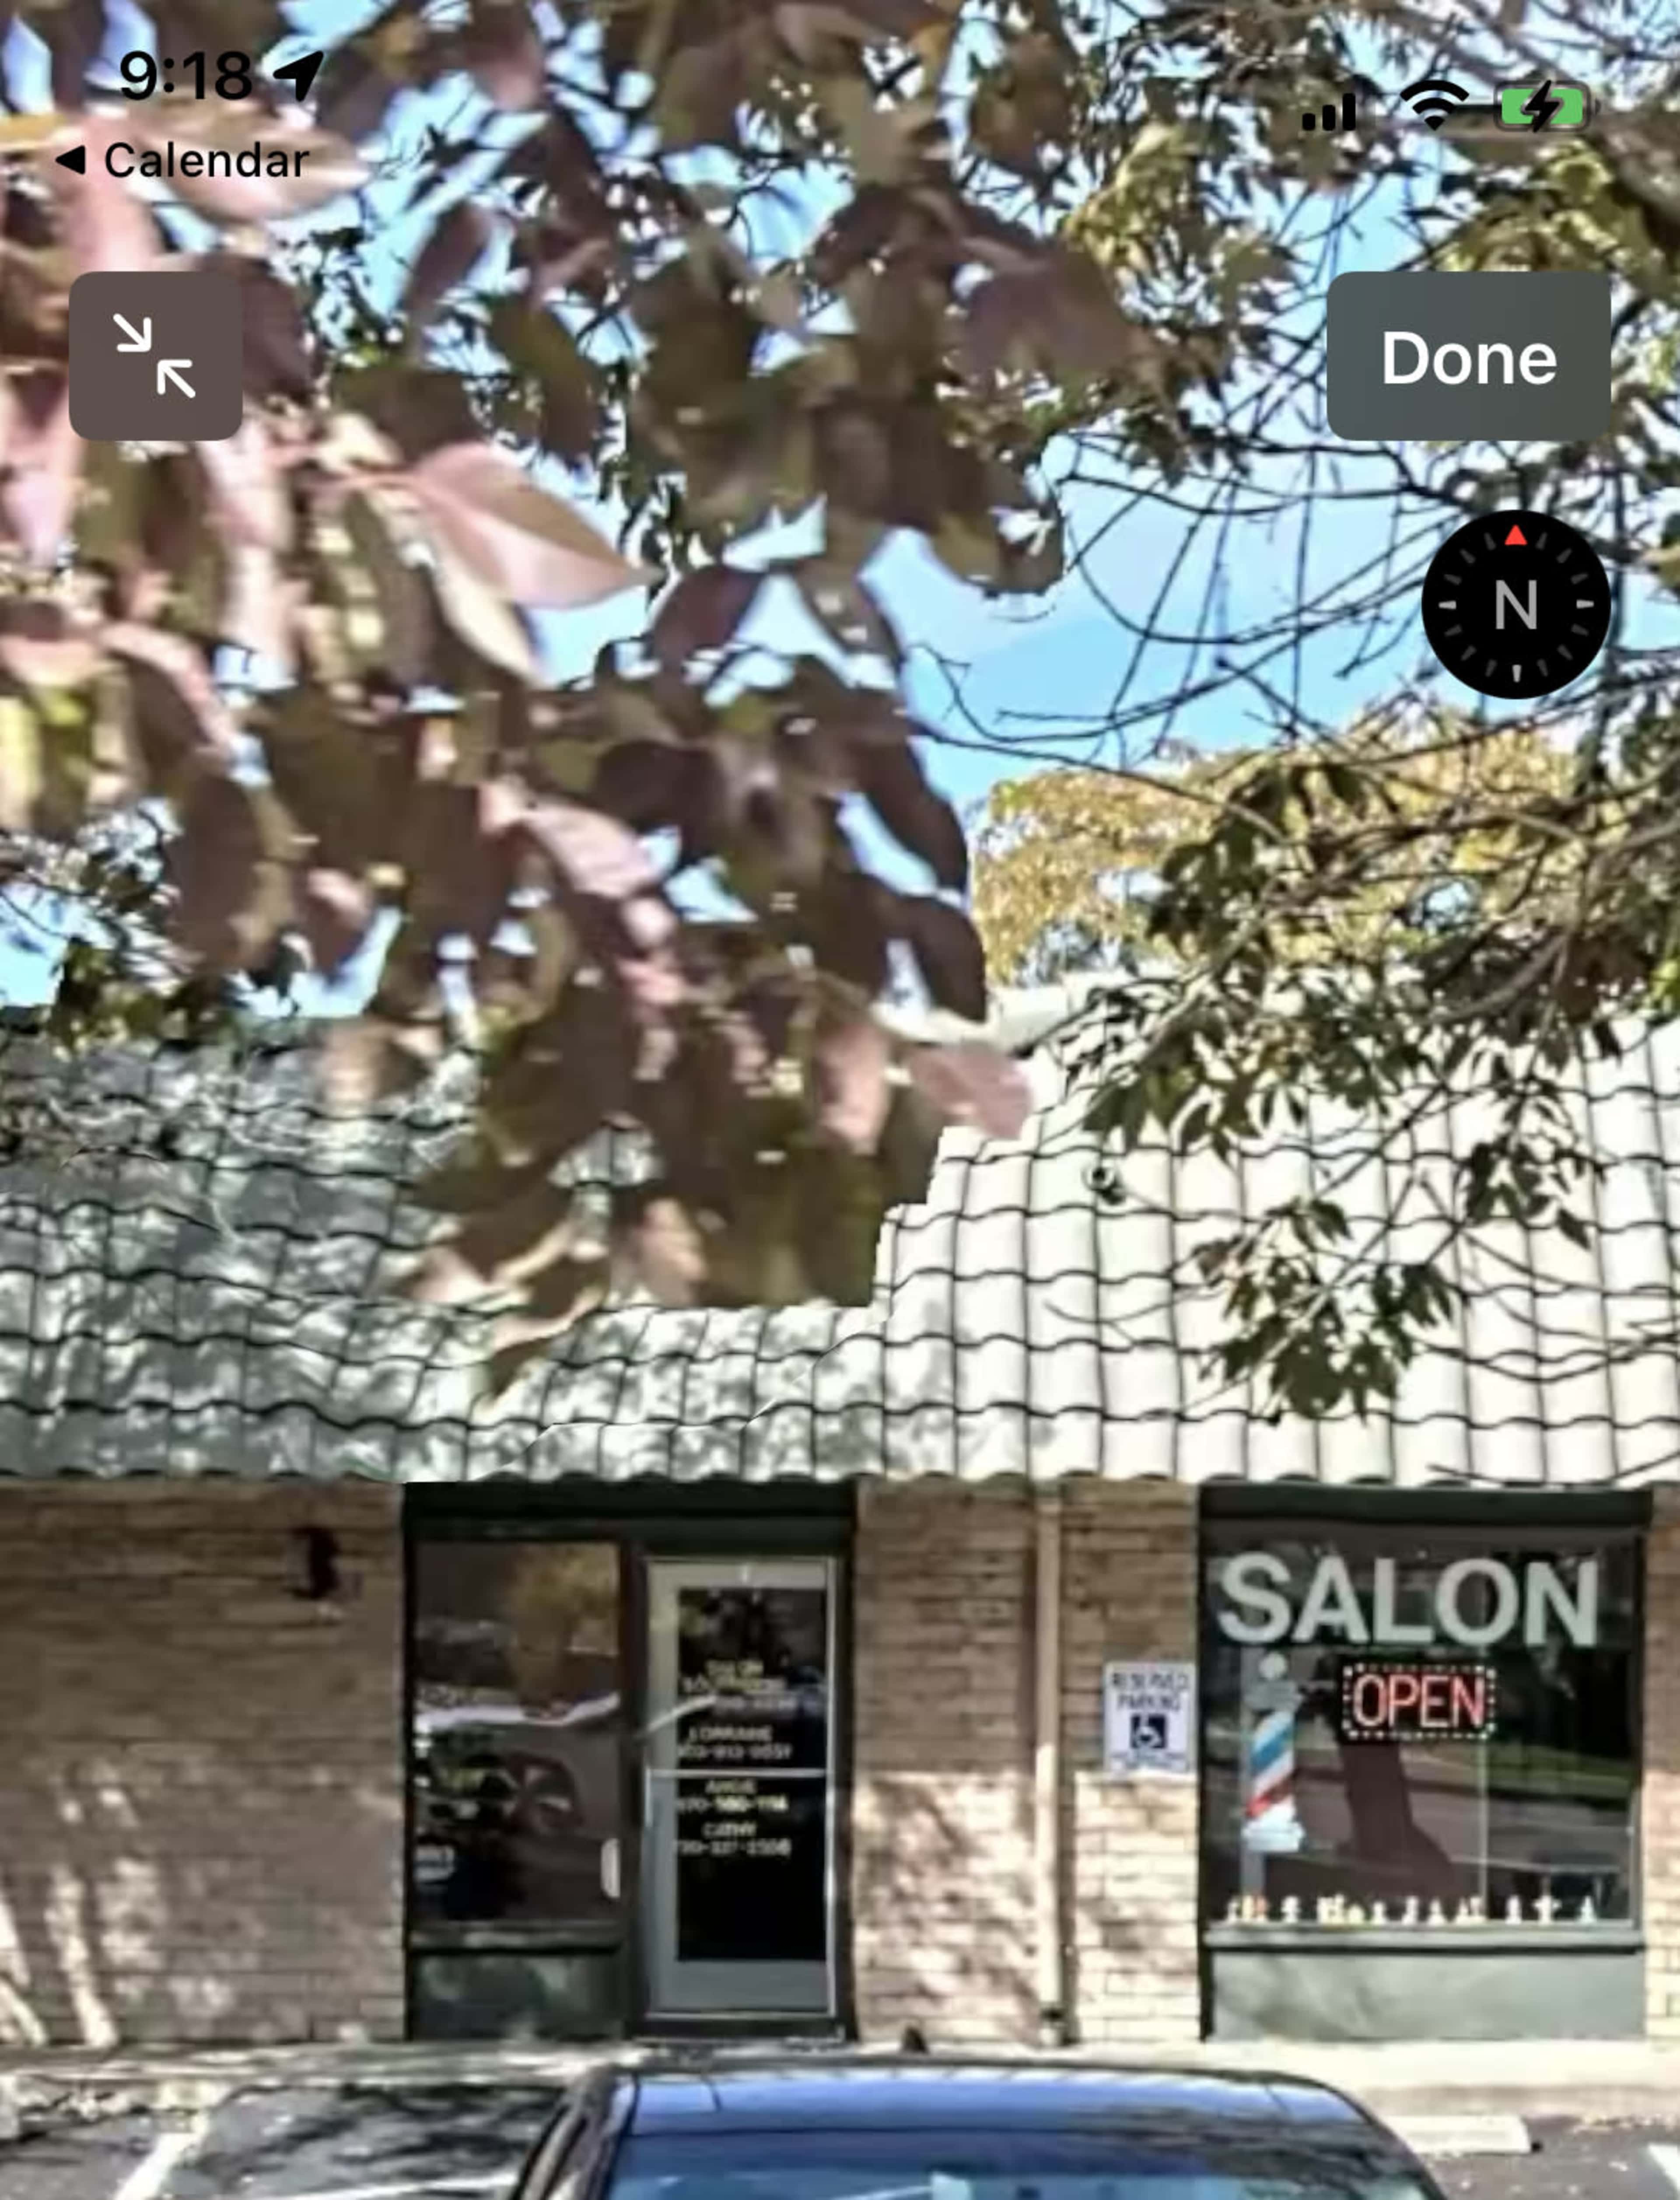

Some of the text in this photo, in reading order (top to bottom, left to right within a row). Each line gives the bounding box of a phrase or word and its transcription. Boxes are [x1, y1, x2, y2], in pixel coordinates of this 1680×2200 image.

[1218, 1551, 1600, 1647] SALON
[1117, 1693, 1181, 1710] PARKING
[1352, 1673, 1485, 1728] OPEN
